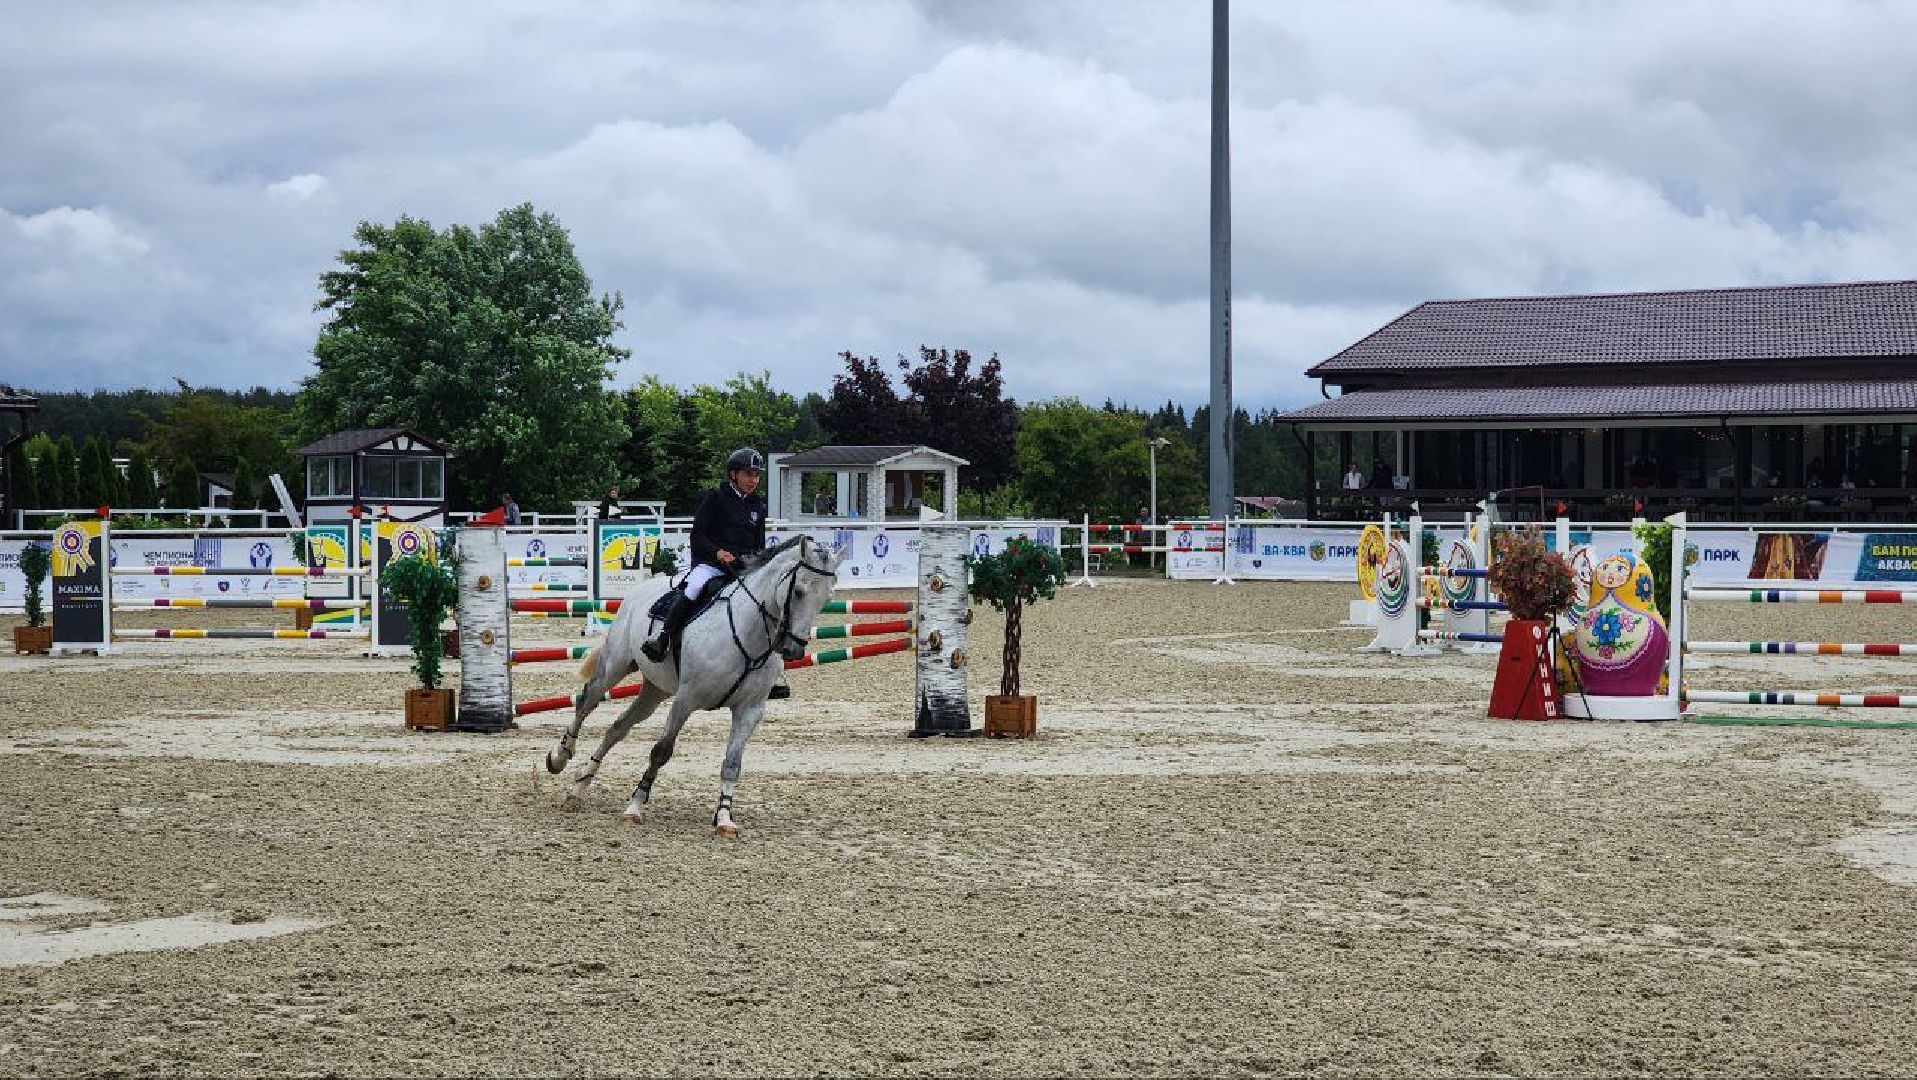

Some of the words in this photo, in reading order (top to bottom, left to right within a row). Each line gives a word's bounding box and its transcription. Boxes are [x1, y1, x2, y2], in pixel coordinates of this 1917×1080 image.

[1262, 545, 1306, 556] ВА-КВА
[1703, 548, 1741, 561] ПАРК
[1872, 545, 1900, 556] ВАМ
[58, 585, 101, 594] MAXIMA
